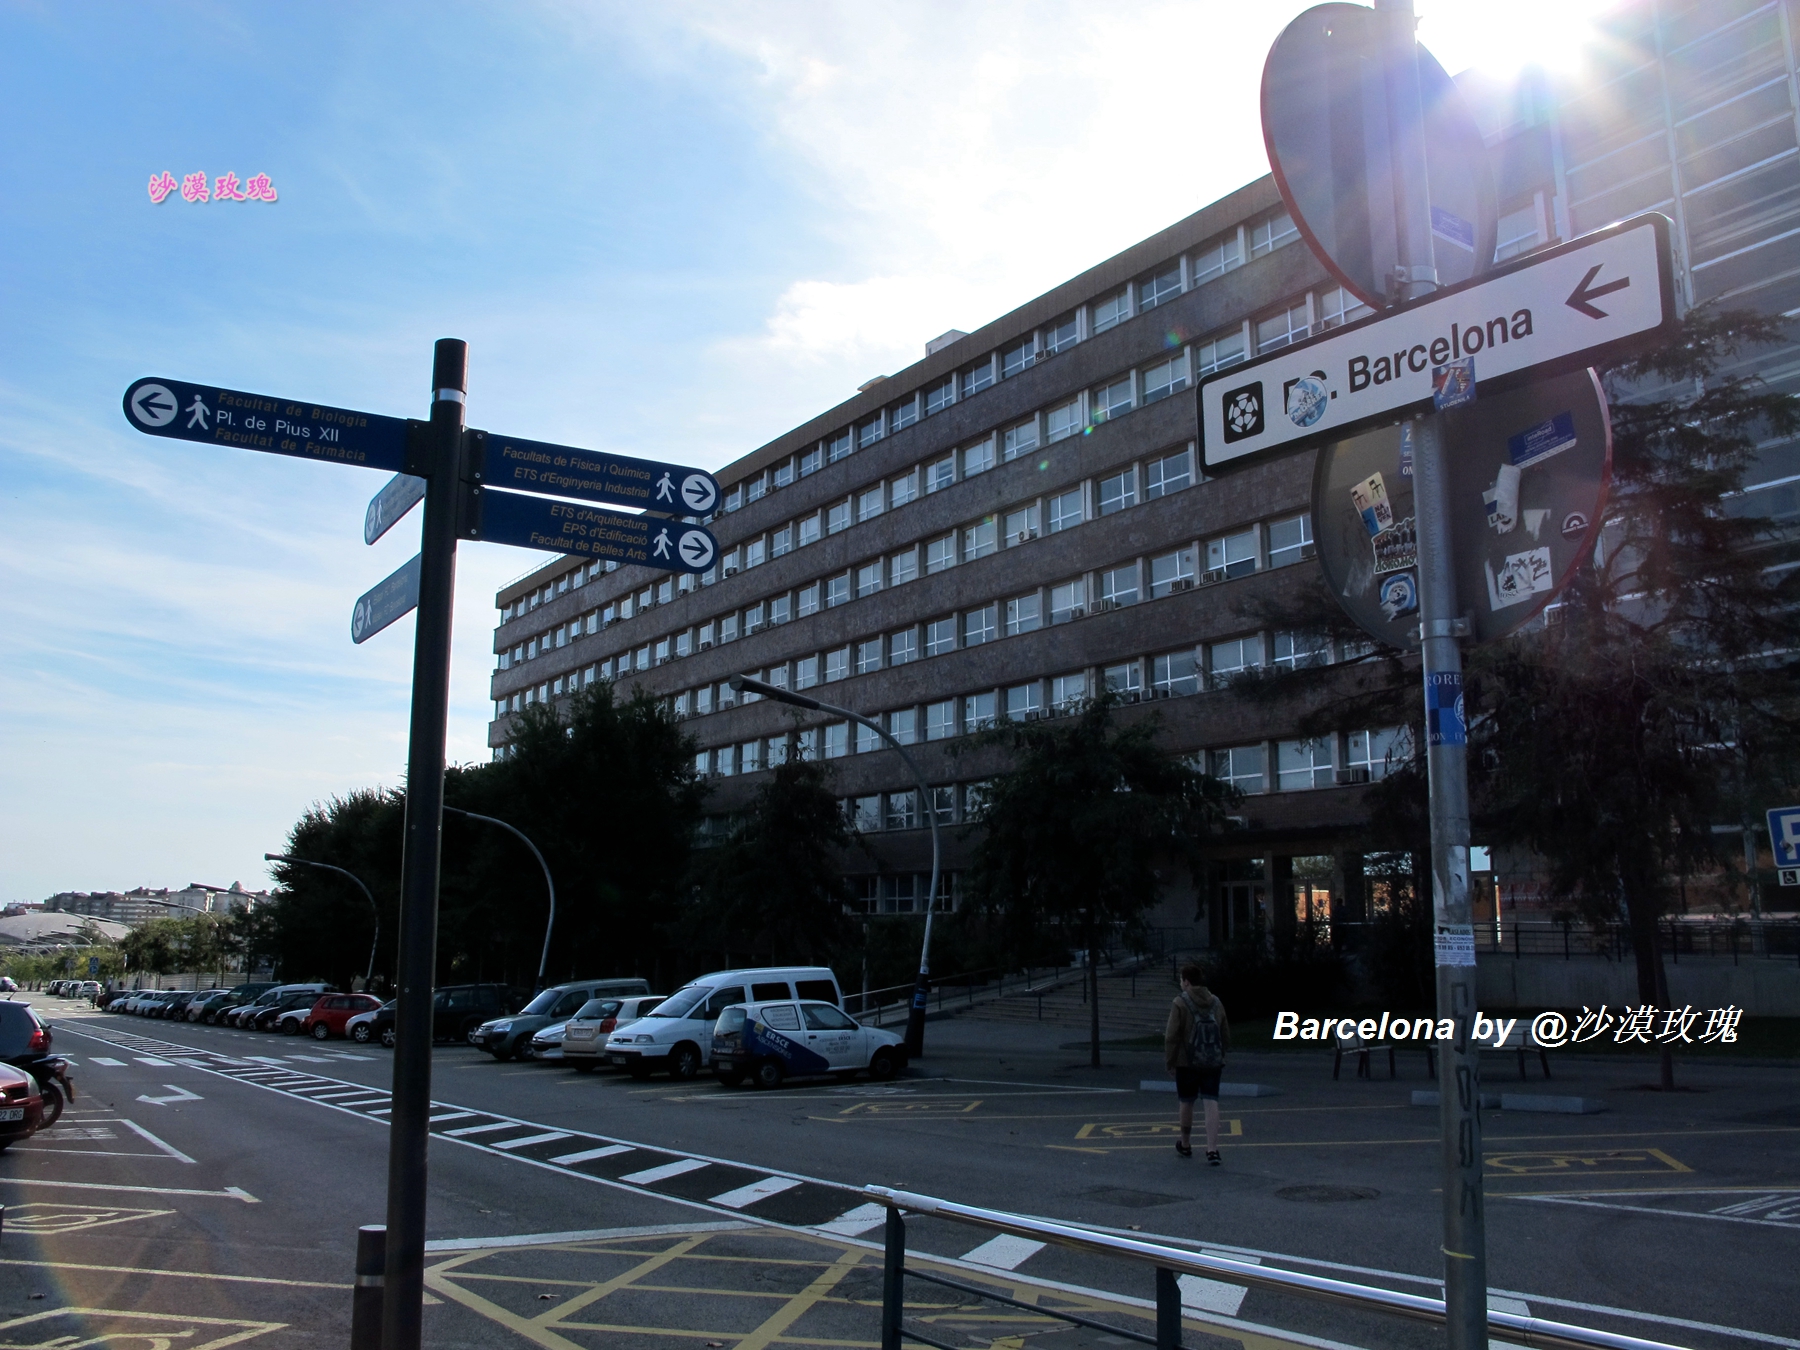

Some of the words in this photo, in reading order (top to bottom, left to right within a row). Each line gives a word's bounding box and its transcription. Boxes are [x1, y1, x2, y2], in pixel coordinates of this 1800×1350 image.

[1348, 308, 1533, 393] Barcelona
[218, 392, 279, 413] Facultat
[286, 405, 302, 417] de
[312, 408, 368, 428] Biologia
[216, 410, 236, 426] Pl.
[244, 416, 266, 431] de
[275, 419, 311, 438] Pius
[319, 426, 339, 442] XII
[215, 427, 274, 447] Facultat
[281, 438, 297, 451] de
[305, 441, 366, 461] Farmàcia
[502, 446, 551, 464] Facultats
[554, 455, 567, 466] de
[570, 457, 601, 472] Física
[514, 467, 538, 481] ETS
[540, 471, 601, 491] d'Enginyeria
[604, 481, 650, 498] Industrial
[550, 504, 575, 519] ETS
[577, 510, 648, 531] d'Arquitectura
[530, 532, 573, 549] Facultat
[575, 540, 589, 551] de
[592, 542, 624, 557] Belles
[626, 548, 647, 561] Arts
[562, 522, 587, 536] EPS
[589, 527, 648, 545] d'Edificació
[766, 1030, 790, 1049] ERSCE
